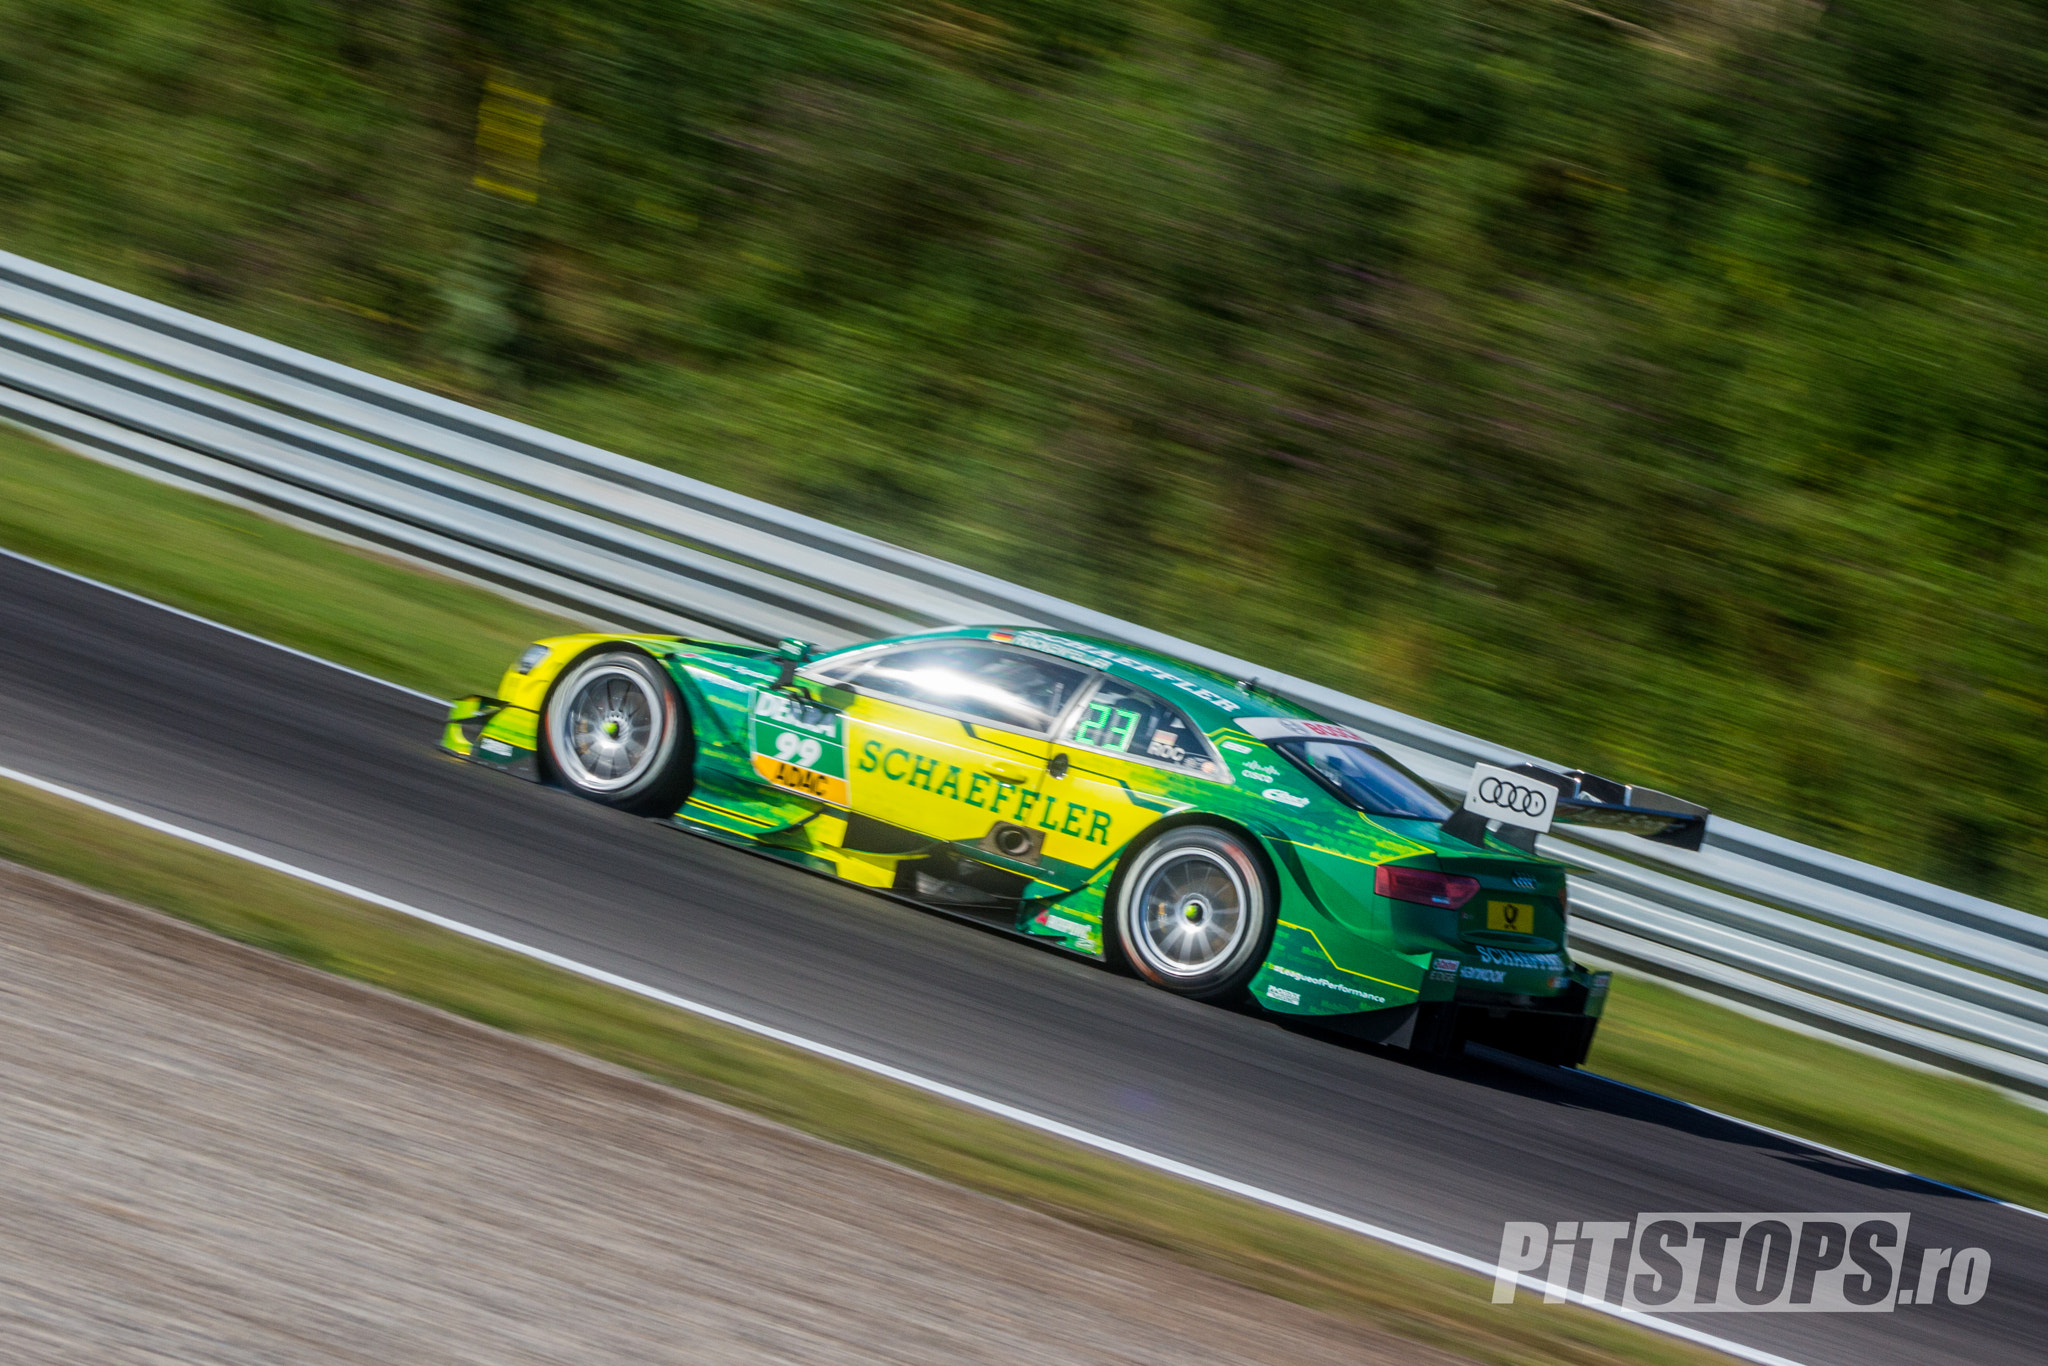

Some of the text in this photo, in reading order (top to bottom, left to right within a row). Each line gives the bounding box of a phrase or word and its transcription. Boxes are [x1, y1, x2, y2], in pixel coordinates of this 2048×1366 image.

[774, 732, 822, 768] 99
[1075, 702, 1140, 753] 23
[858, 740, 1112, 846] SCHAEFFLER
